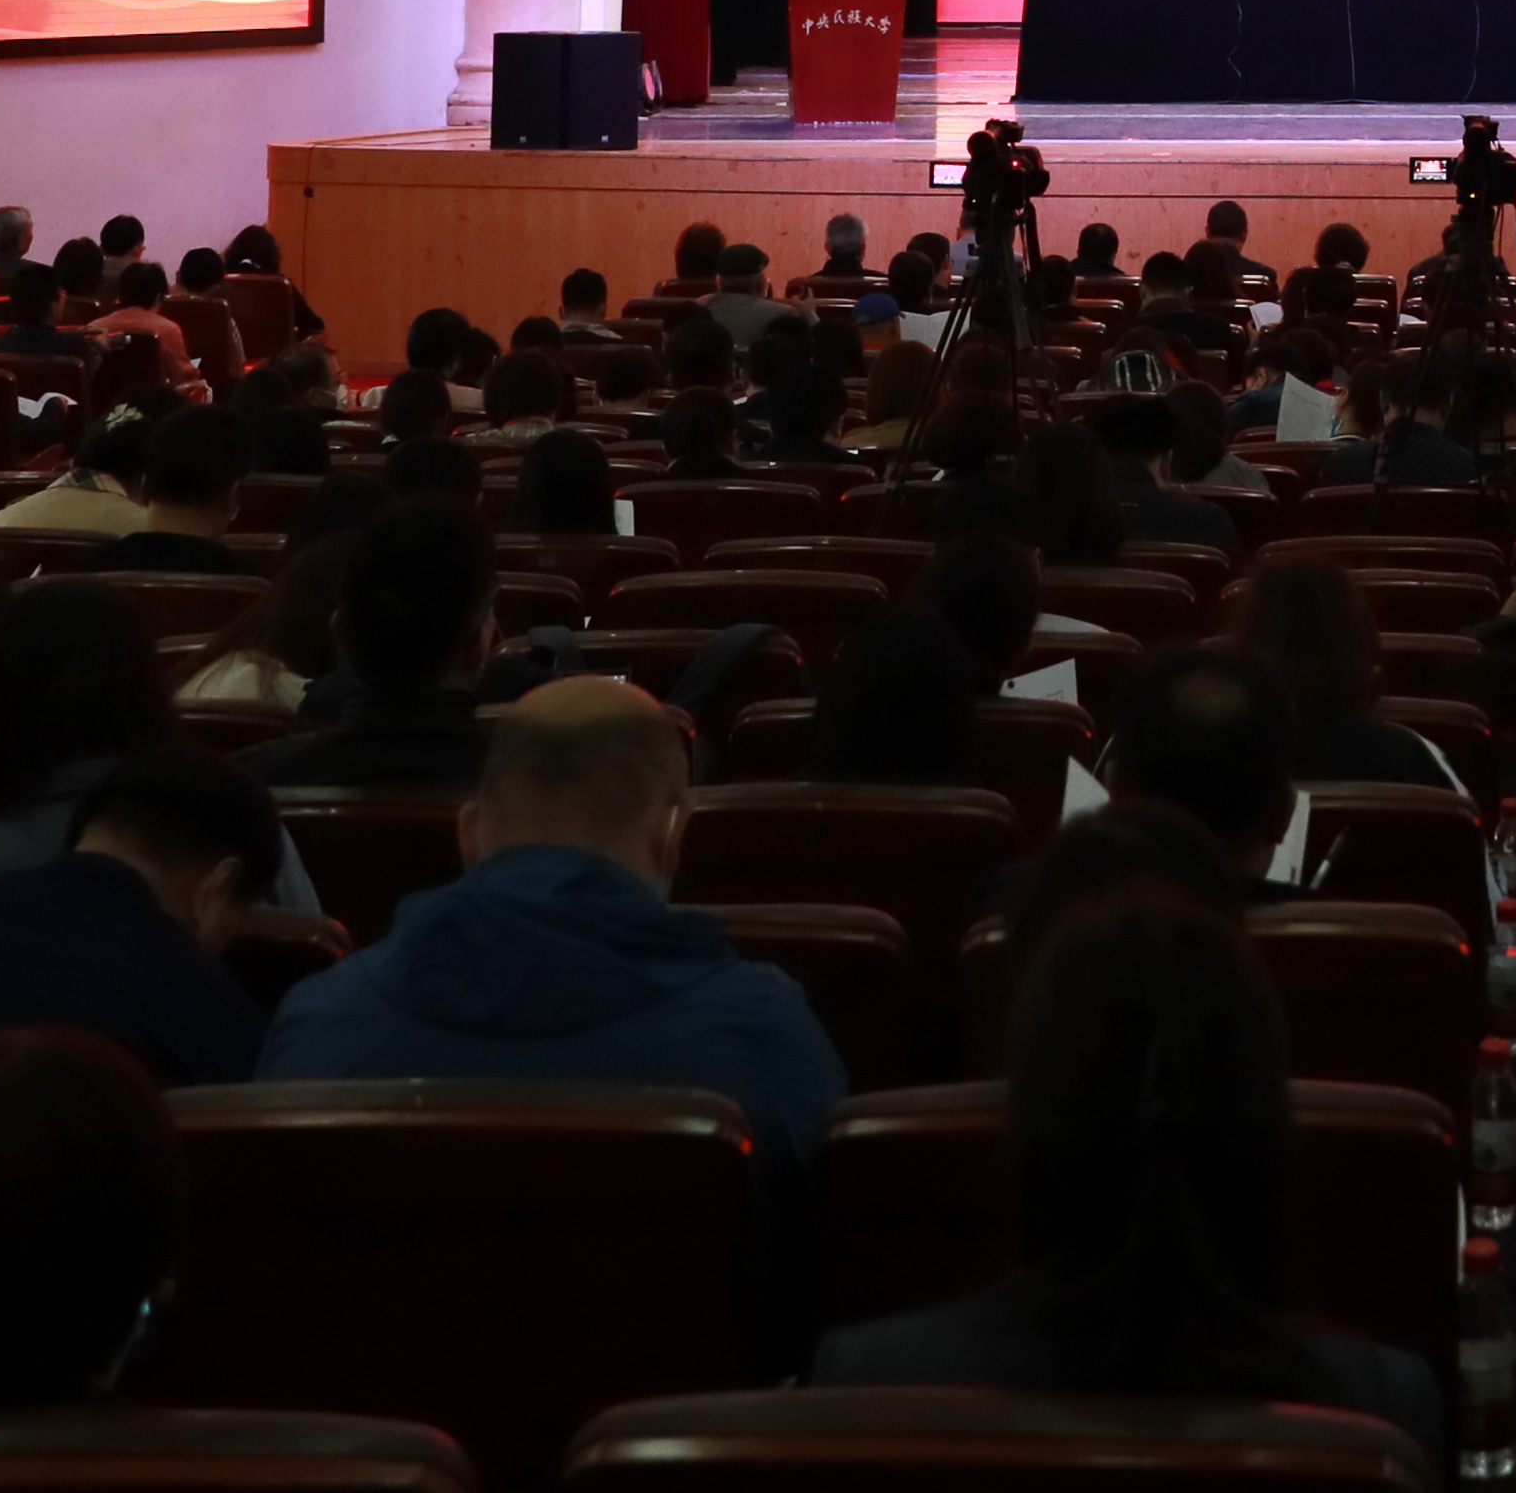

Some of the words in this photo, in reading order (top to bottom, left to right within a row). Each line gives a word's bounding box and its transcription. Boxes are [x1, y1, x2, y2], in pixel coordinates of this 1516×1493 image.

[802, 9, 891, 36] 中央民族大学
